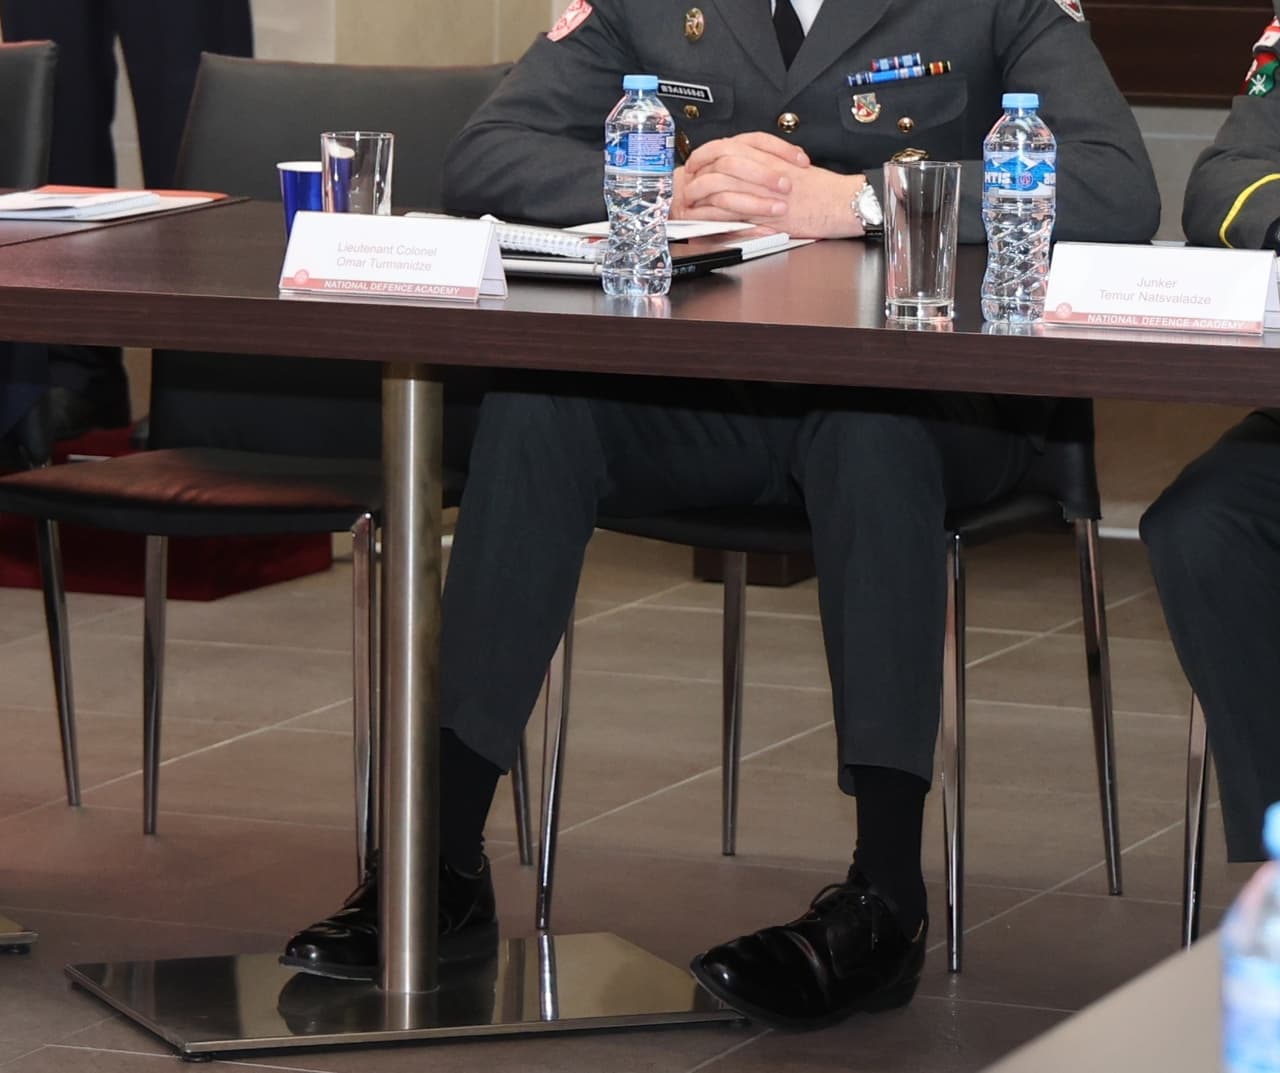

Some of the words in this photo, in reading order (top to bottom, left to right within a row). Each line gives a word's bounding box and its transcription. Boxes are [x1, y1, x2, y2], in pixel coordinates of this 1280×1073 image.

[337, 241, 394, 256] Lieutenant
[396, 243, 437, 257] Colonel
[336, 256, 367, 269] Omar
[370, 257, 433, 272] Turmanidze
[323, 280, 369, 291] NATIONAL
[371, 282, 414, 294] DEFENCE
[414, 285, 460, 296] ACADEMY
[1136, 277, 1177, 289] Junker
[1099, 289, 1135, 302] Temur
[1139, 291, 1212, 306] Natsvaladze
[1087, 314, 1137, 325] NATIONAL
[1142, 316, 1189, 328] DEFENCE
[1192, 318, 1243, 330] ACADEMY
